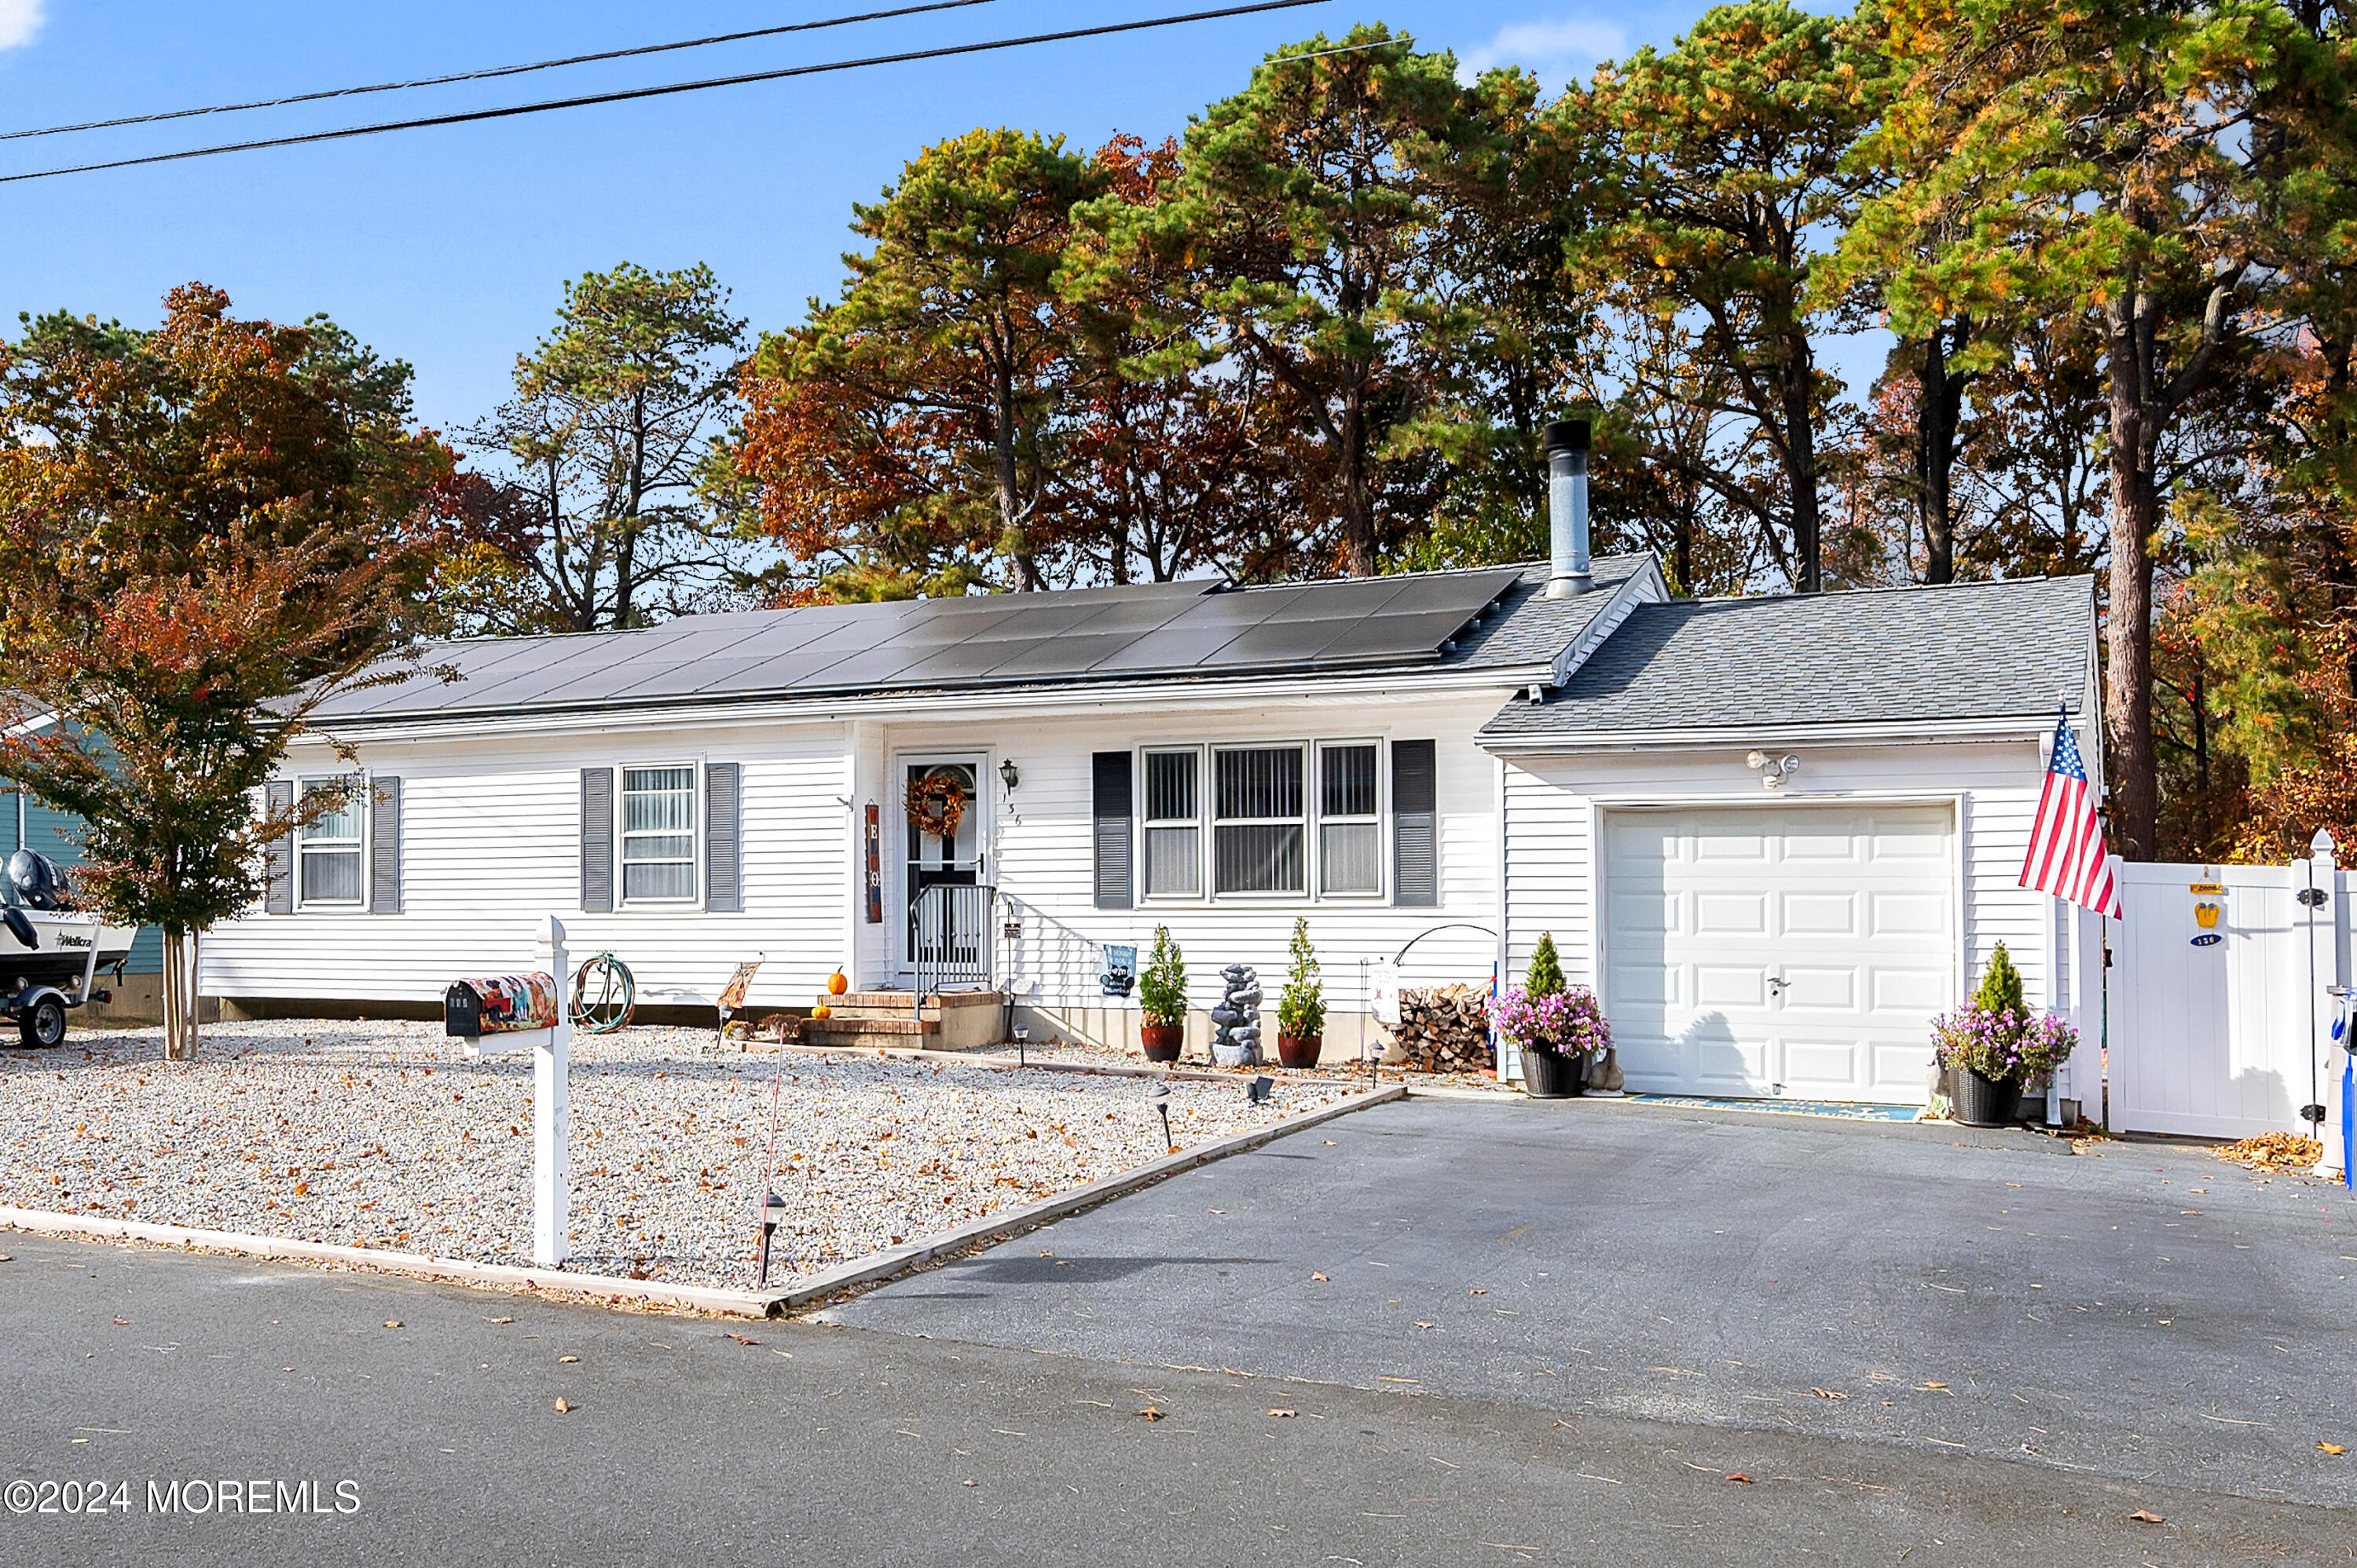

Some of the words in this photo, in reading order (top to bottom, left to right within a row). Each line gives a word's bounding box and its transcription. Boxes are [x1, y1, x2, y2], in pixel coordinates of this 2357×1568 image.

[1003, 793, 1021, 826] 136
[868, 808, 880, 918] WELCOME
[61, 935, 92, 947] Wellcra
